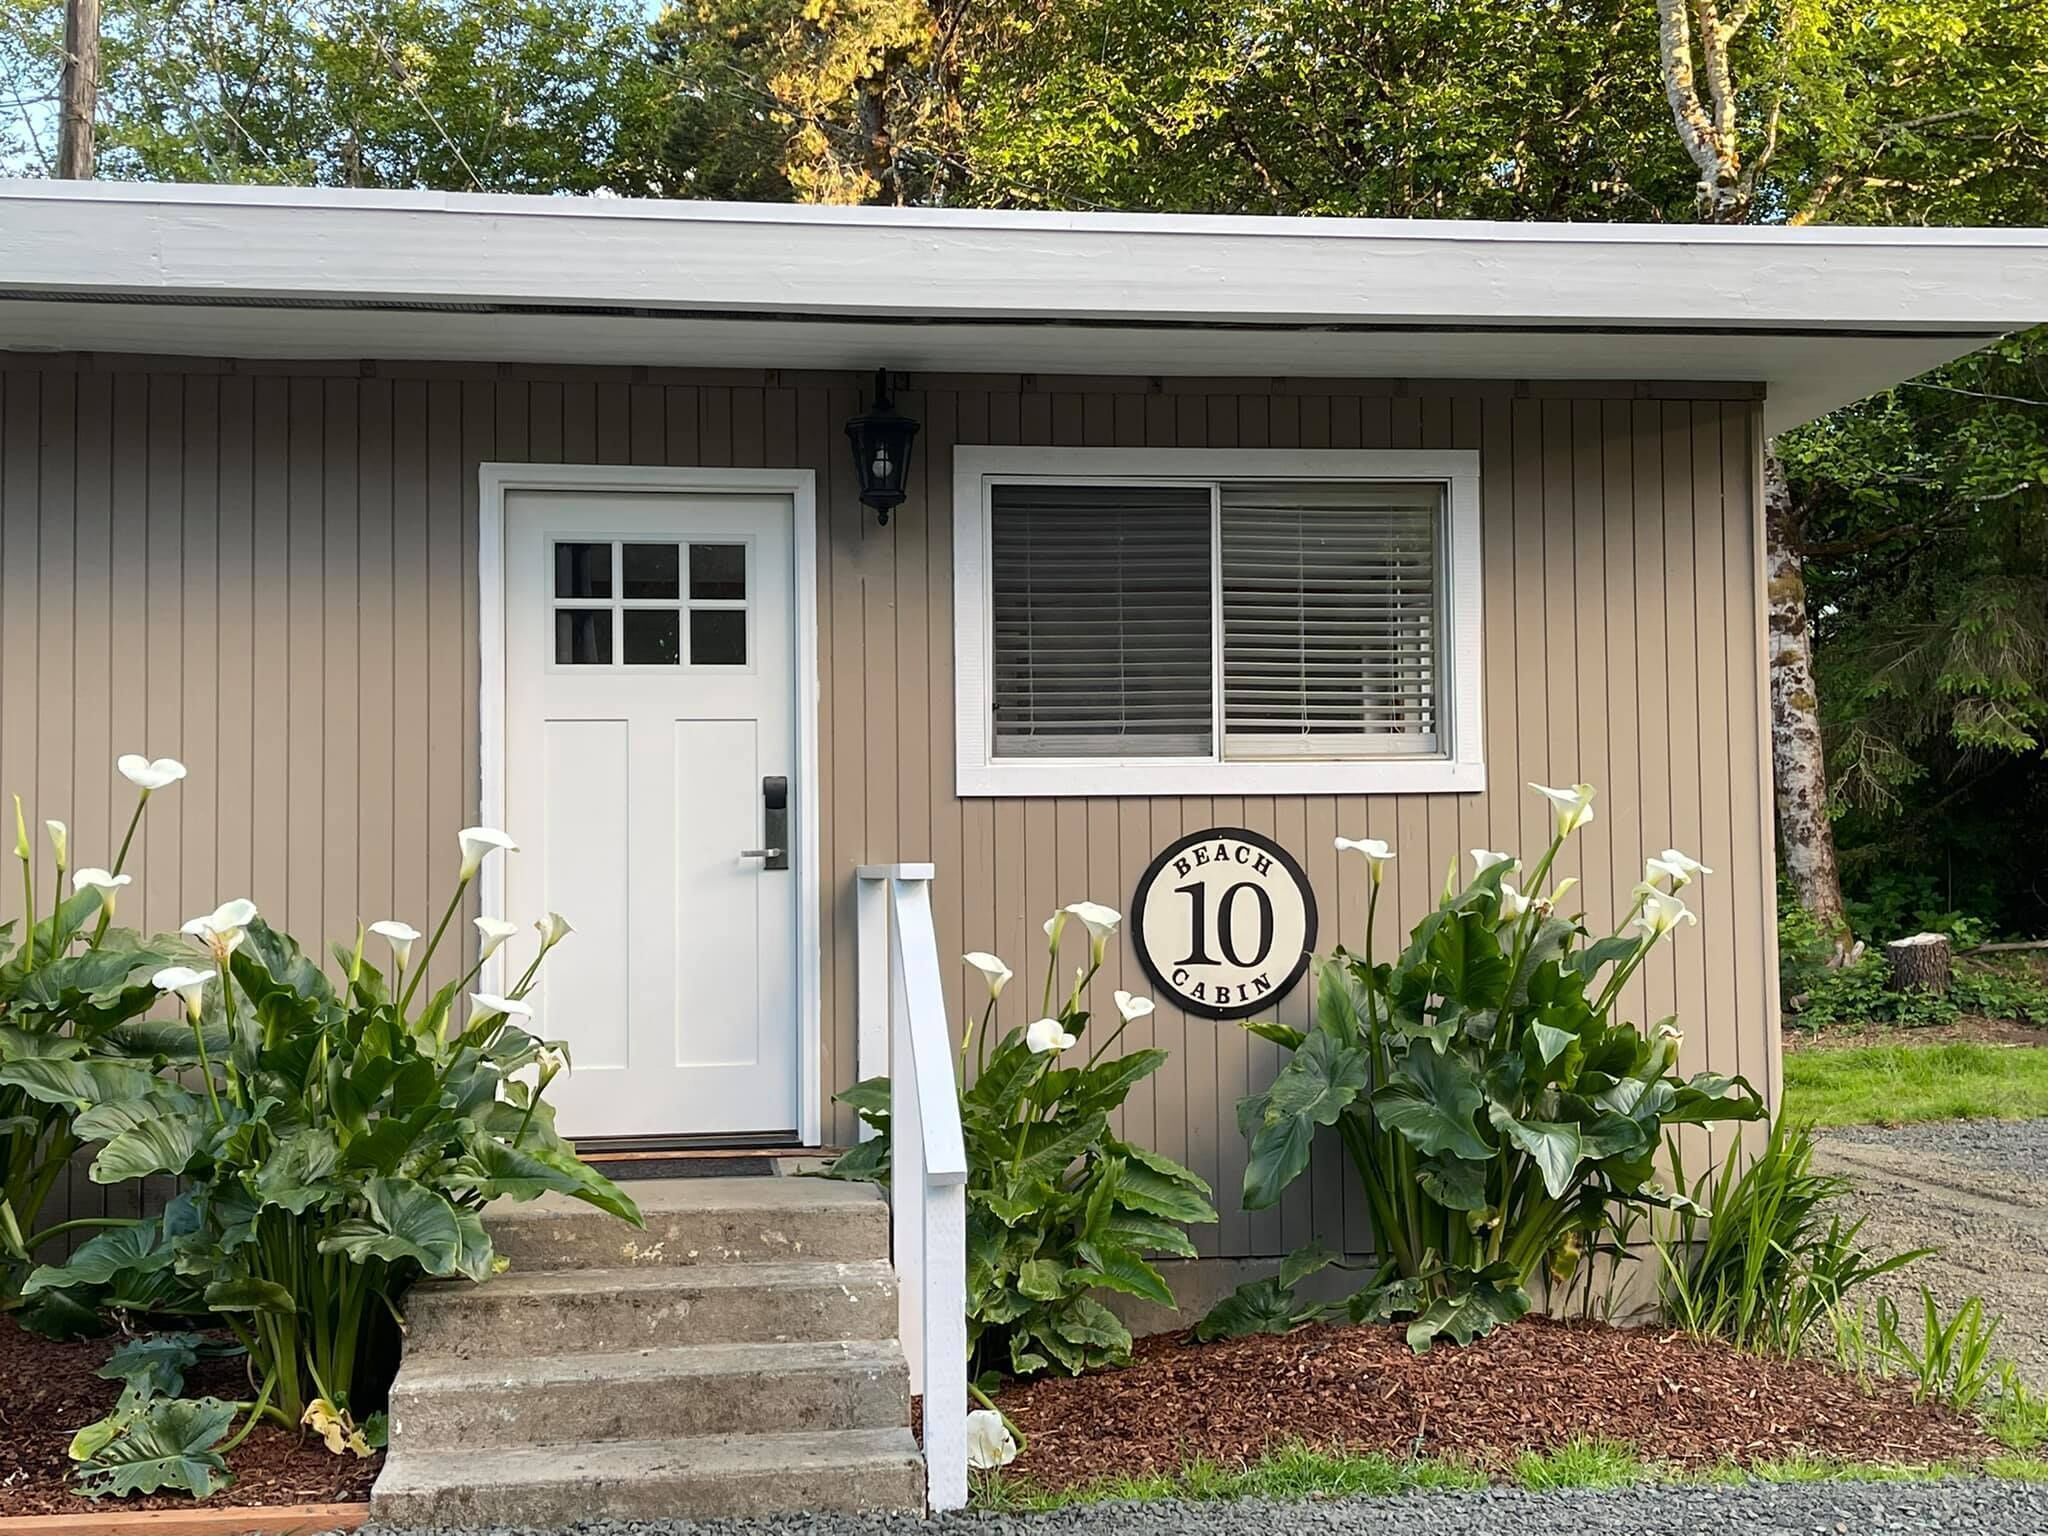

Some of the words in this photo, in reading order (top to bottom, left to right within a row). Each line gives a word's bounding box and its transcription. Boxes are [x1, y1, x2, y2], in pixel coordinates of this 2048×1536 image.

[1172, 843, 1274, 879] BEACH
[1173, 881, 1274, 968] 10
[1172, 968, 1272, 1004] CABIN
